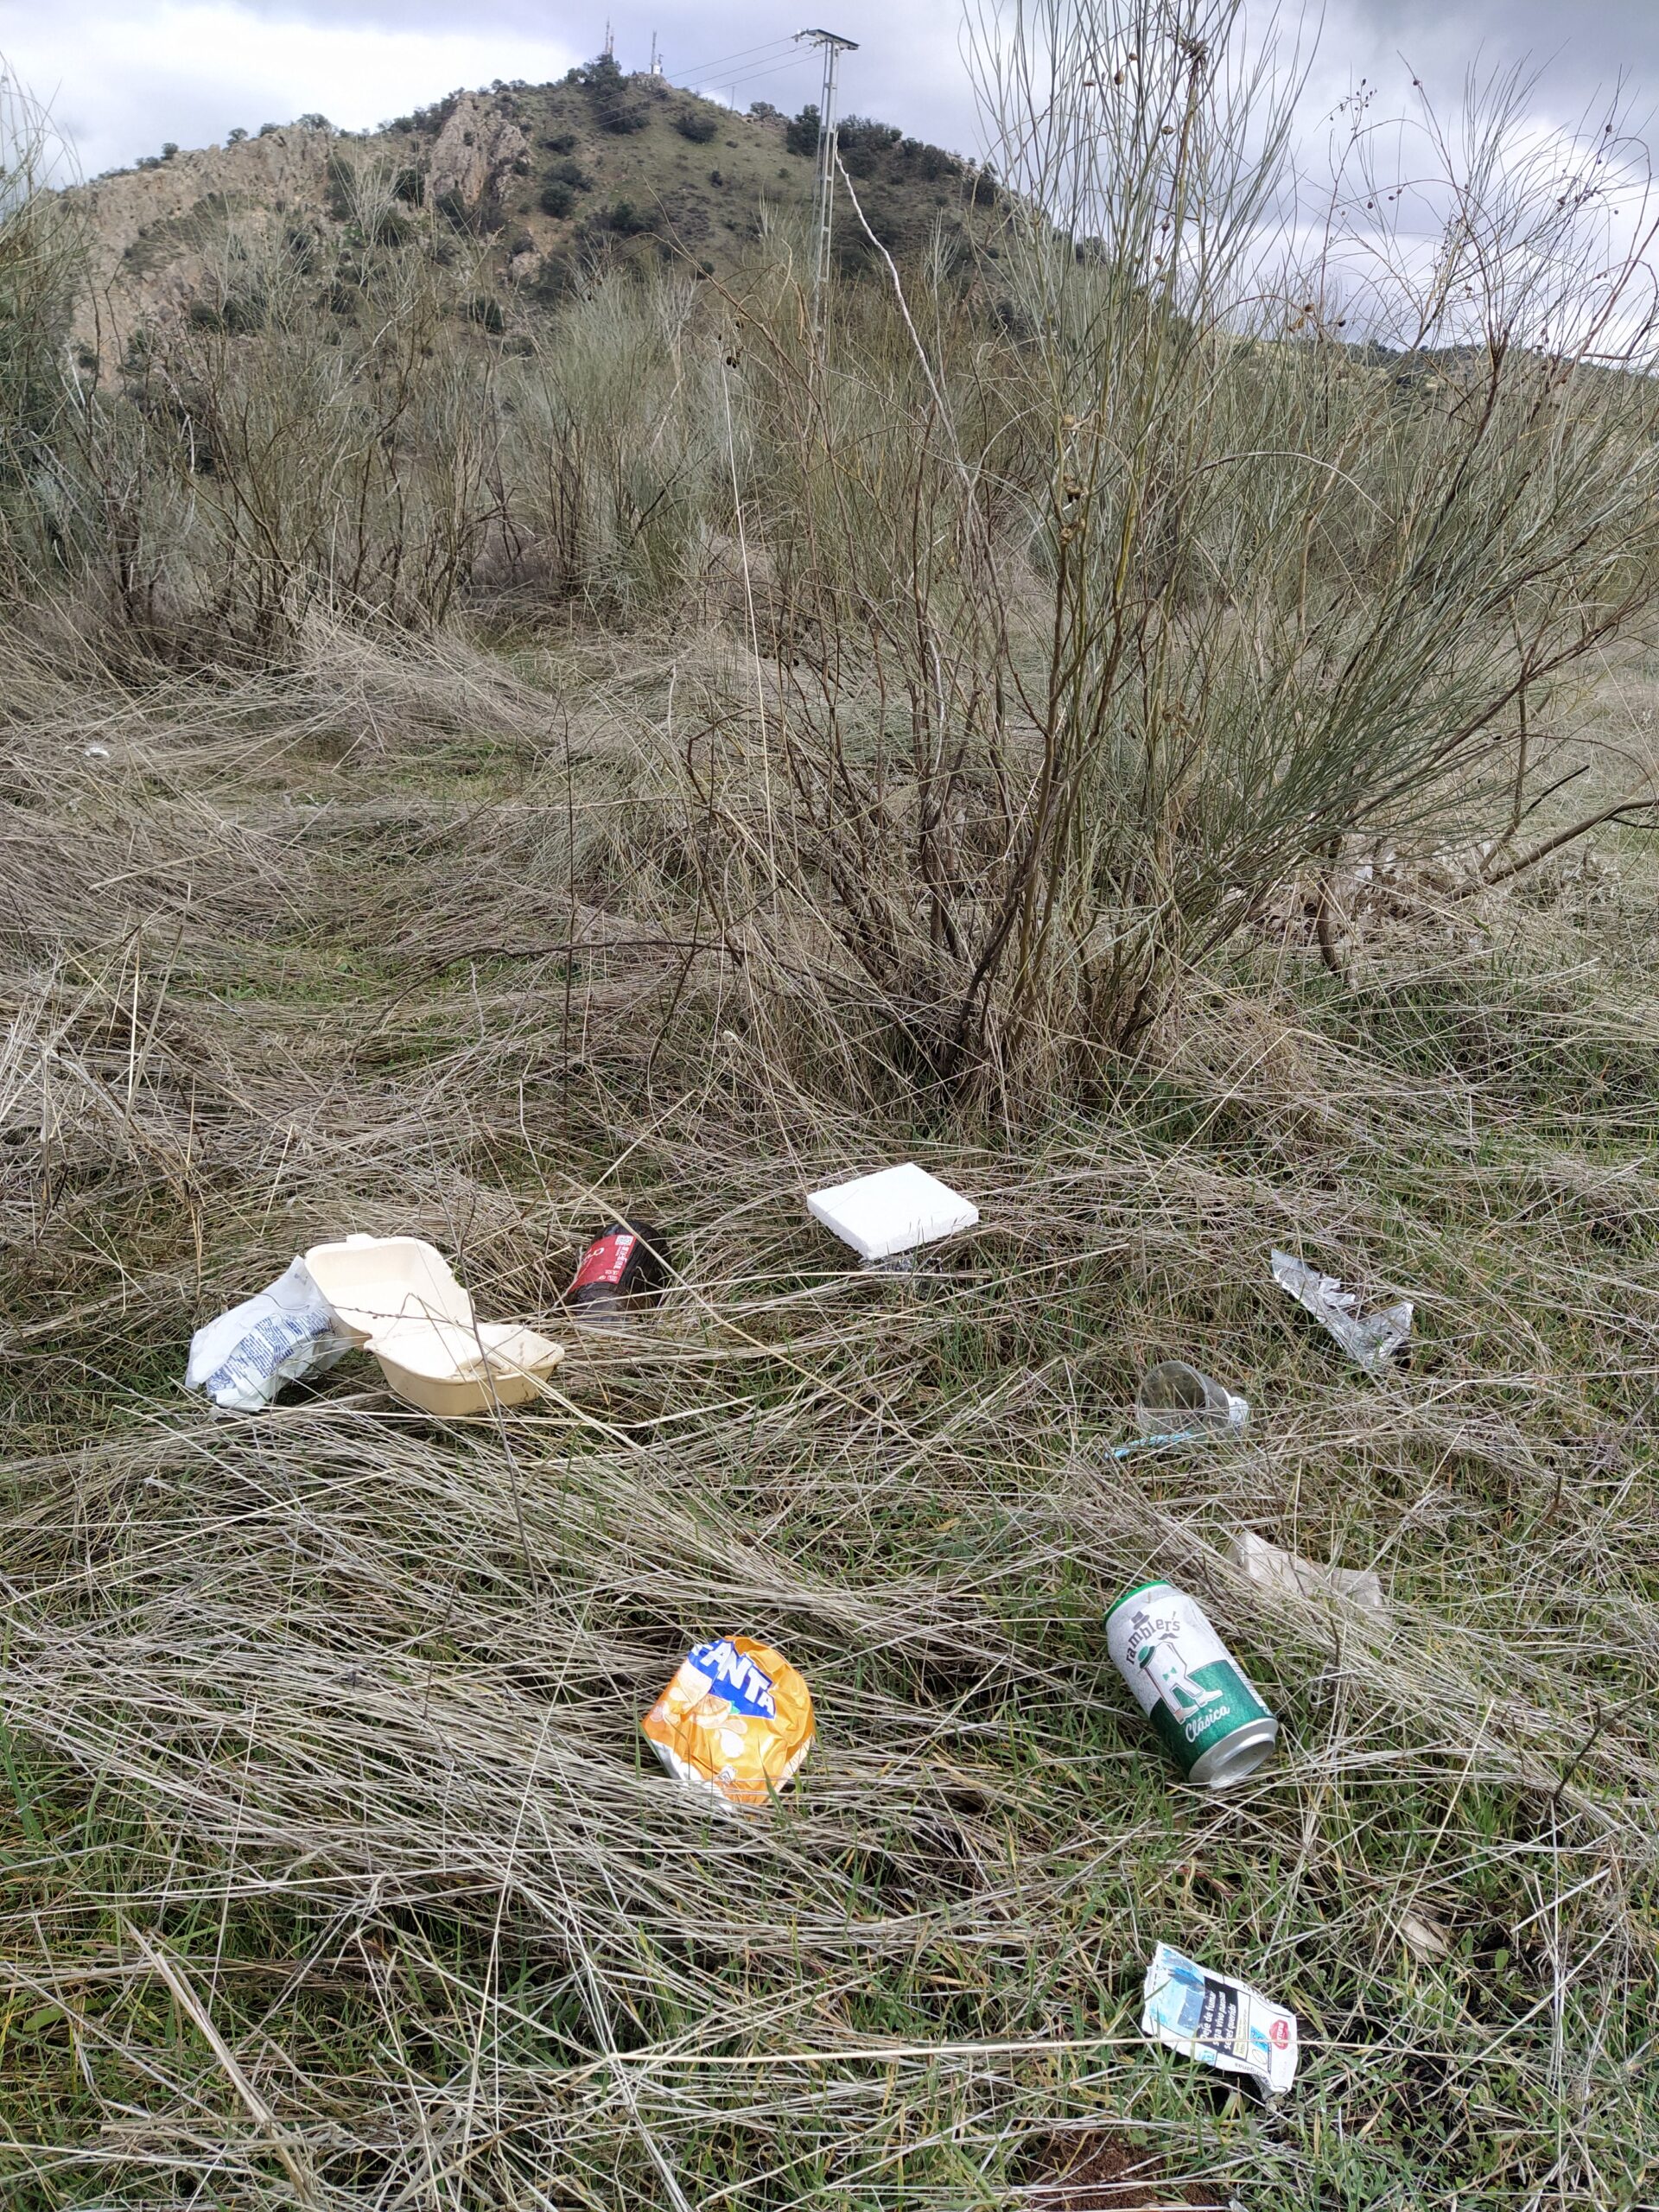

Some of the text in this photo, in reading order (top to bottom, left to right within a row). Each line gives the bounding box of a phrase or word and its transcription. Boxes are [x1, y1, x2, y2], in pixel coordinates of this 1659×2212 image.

[691, 1640, 776, 1716] FANTA
[1185, 1705, 1230, 1743] Clásica
[1205, 1990, 1217, 2012] fumar
[1203, 2012, 1213, 2023] de
[1215, 2012, 1224, 2027] vivo
[1199, 2023, 1211, 2039] Deje
[1212, 2029, 1223, 2046] sga
